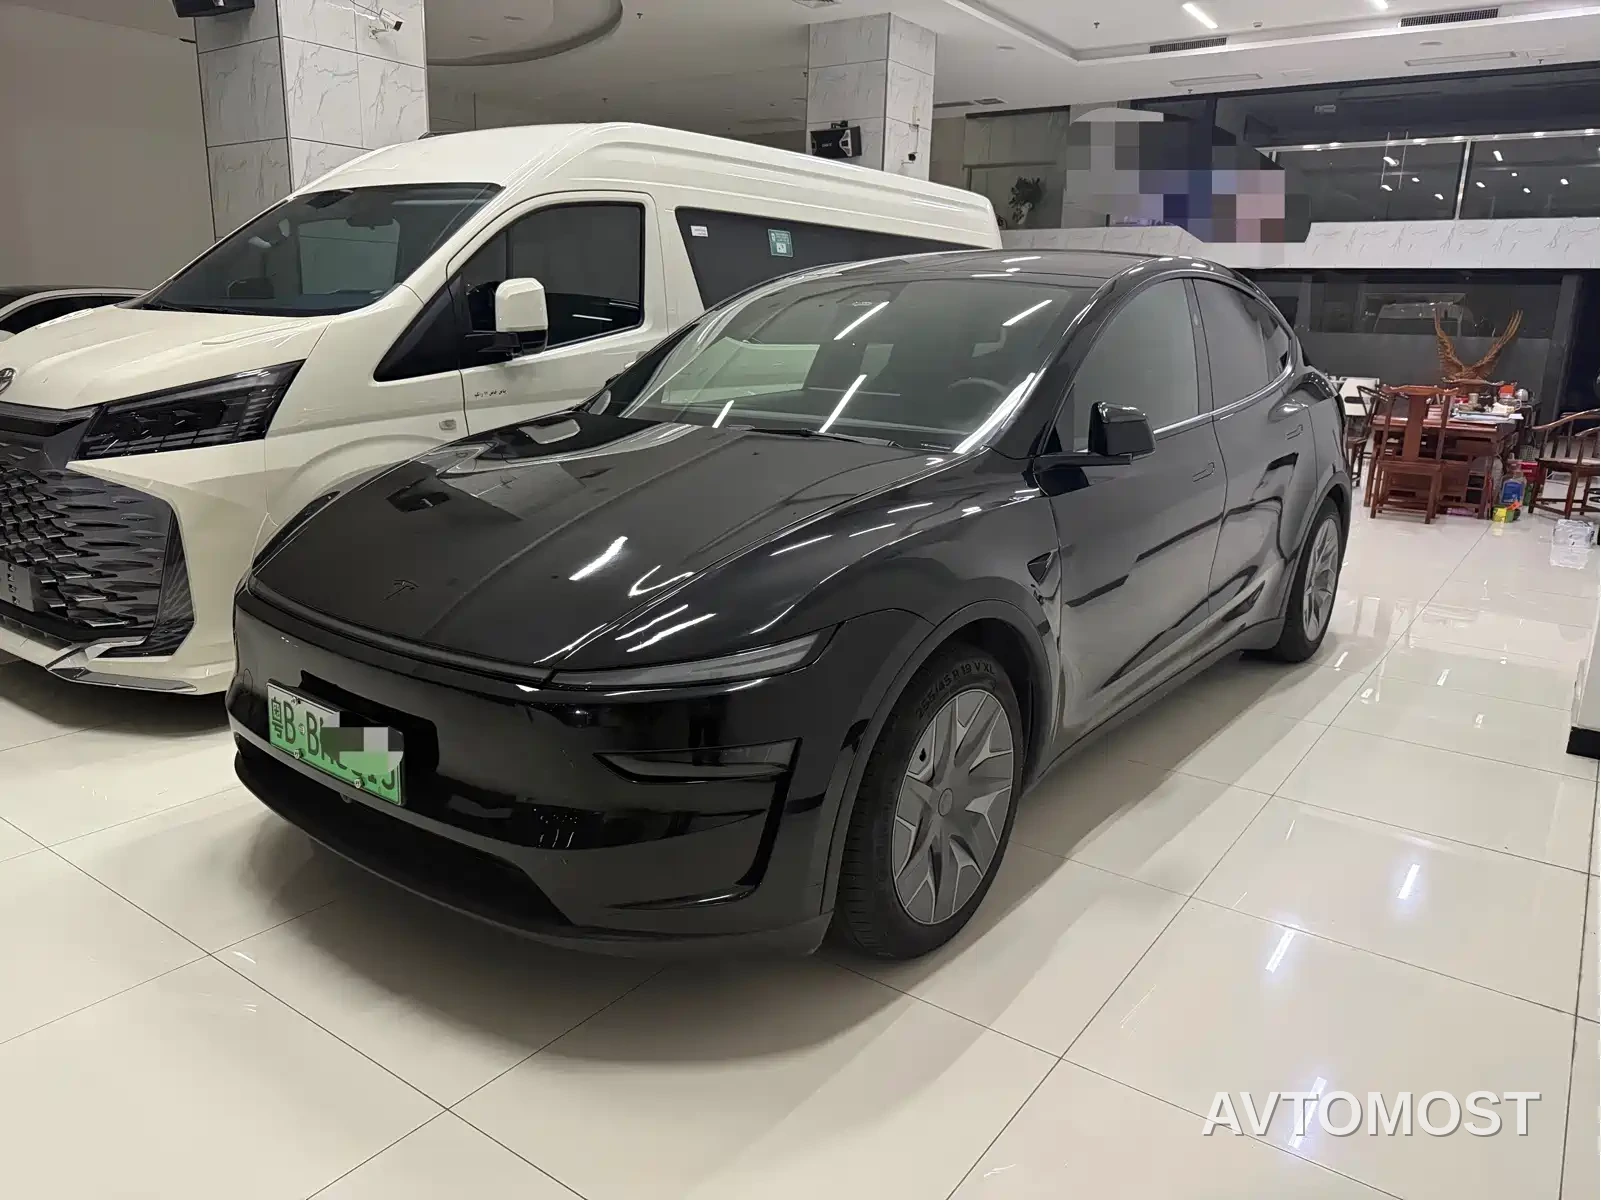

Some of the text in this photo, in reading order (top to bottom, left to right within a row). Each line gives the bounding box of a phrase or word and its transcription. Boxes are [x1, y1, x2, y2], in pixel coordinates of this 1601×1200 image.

[961, 663, 972, 675] 19
[974, 661, 981, 671] V
[983, 662, 996, 675] XL
